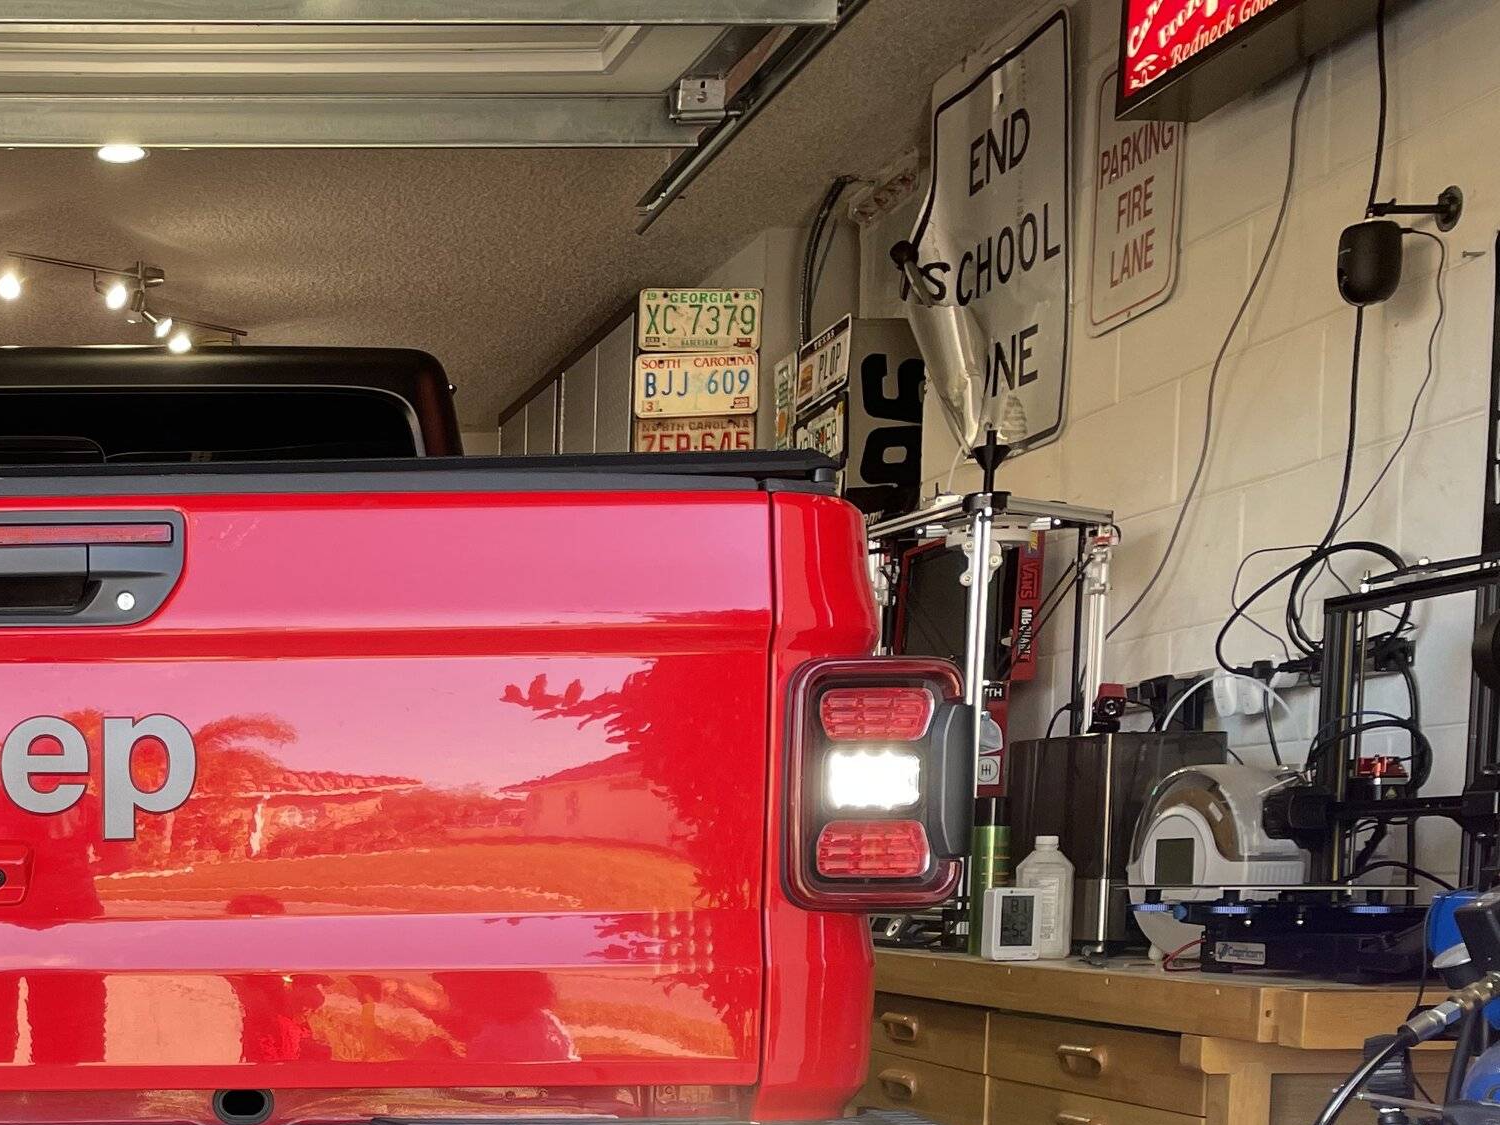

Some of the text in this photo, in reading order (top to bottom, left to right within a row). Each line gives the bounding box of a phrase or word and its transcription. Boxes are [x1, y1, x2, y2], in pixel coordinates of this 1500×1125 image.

[1170, 3, 1236, 68] Redneck
[969, 107, 1031, 197] END
[1101, 120, 1174, 190] PARKING
[1116, 176, 1155, 234] FIRE
[918, 202, 1061, 307] SCHOOL
[1110, 227, 1155, 288] LANE
[645, 303, 756, 336] XC 7379
[669, 292, 734, 304] GEORGIA
[641, 355, 755, 370] SOUTH CAROLINA
[644, 369, 750, 399] BJJ 609
[983, 323, 1039, 399] NE
[688, 420, 749, 431] CAROLNA
